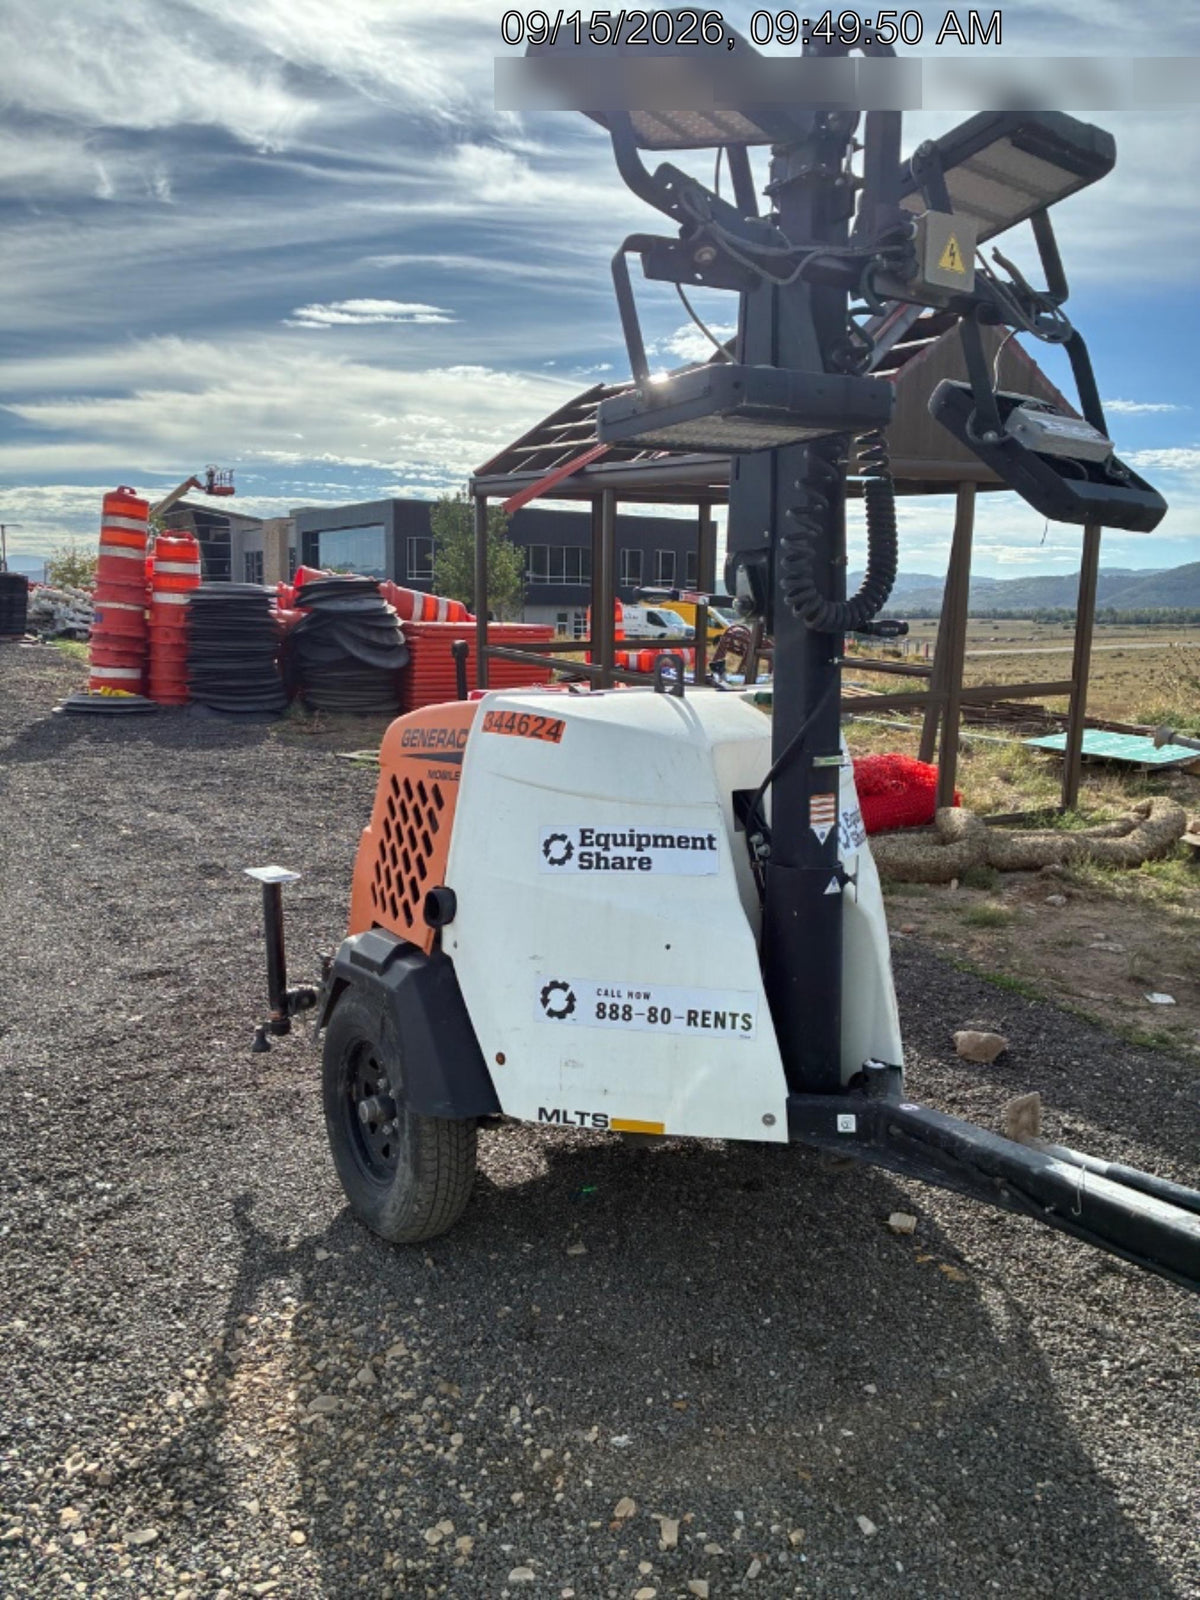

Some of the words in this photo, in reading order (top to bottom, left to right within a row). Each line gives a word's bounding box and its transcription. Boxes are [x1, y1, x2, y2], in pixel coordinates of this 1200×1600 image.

[484, 711, 564, 742] 344624
[401, 728, 469, 748] GENERAC
[578, 828, 717, 852] Equipment
[578, 851, 653, 871] Share
[596, 988, 622, 998] CALL
[627, 990, 651, 1000] NOW
[595, 1002, 753, 1031] 888-80-RENTS
[538, 1107, 609, 1128] MLTS
